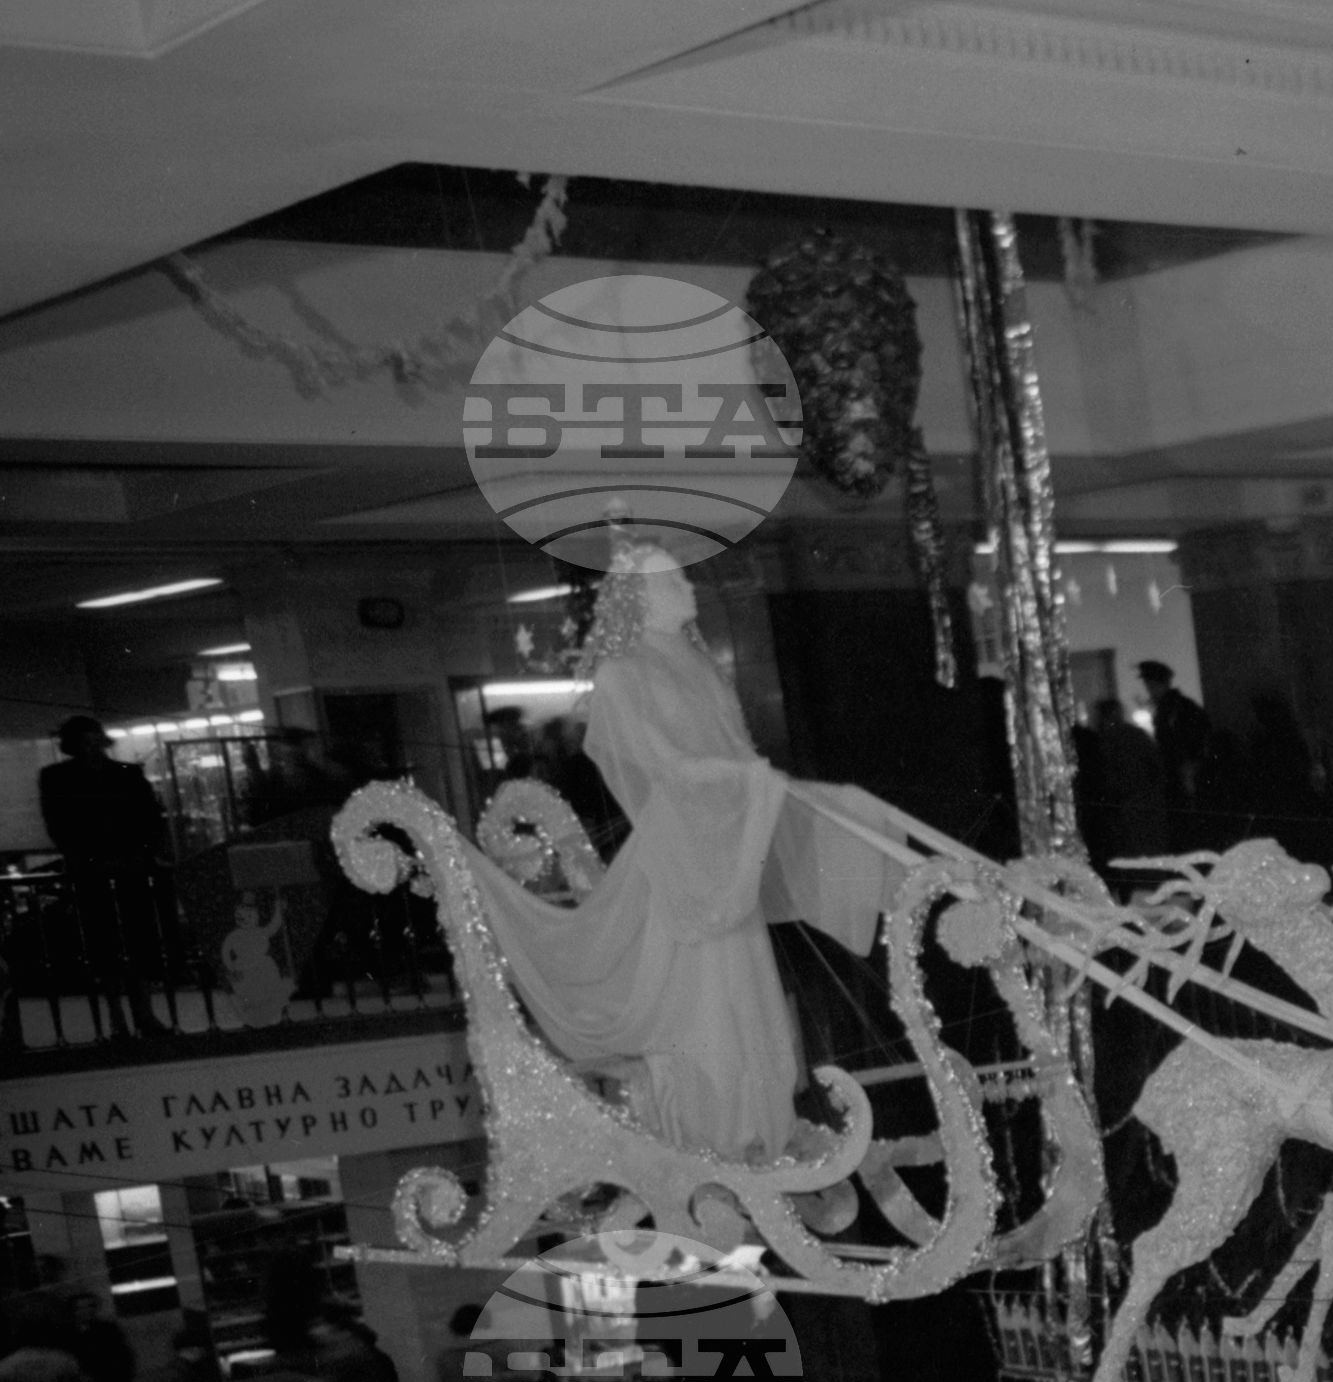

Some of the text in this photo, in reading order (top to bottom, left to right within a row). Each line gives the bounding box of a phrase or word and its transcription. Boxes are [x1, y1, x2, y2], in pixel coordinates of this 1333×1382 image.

[0, 1063, 477, 1137] ШАТА ГЛАВНА ЗАДАЧА
[0, 1095, 490, 1172] ВАМЕ КУЛТУРНО ТРУ
